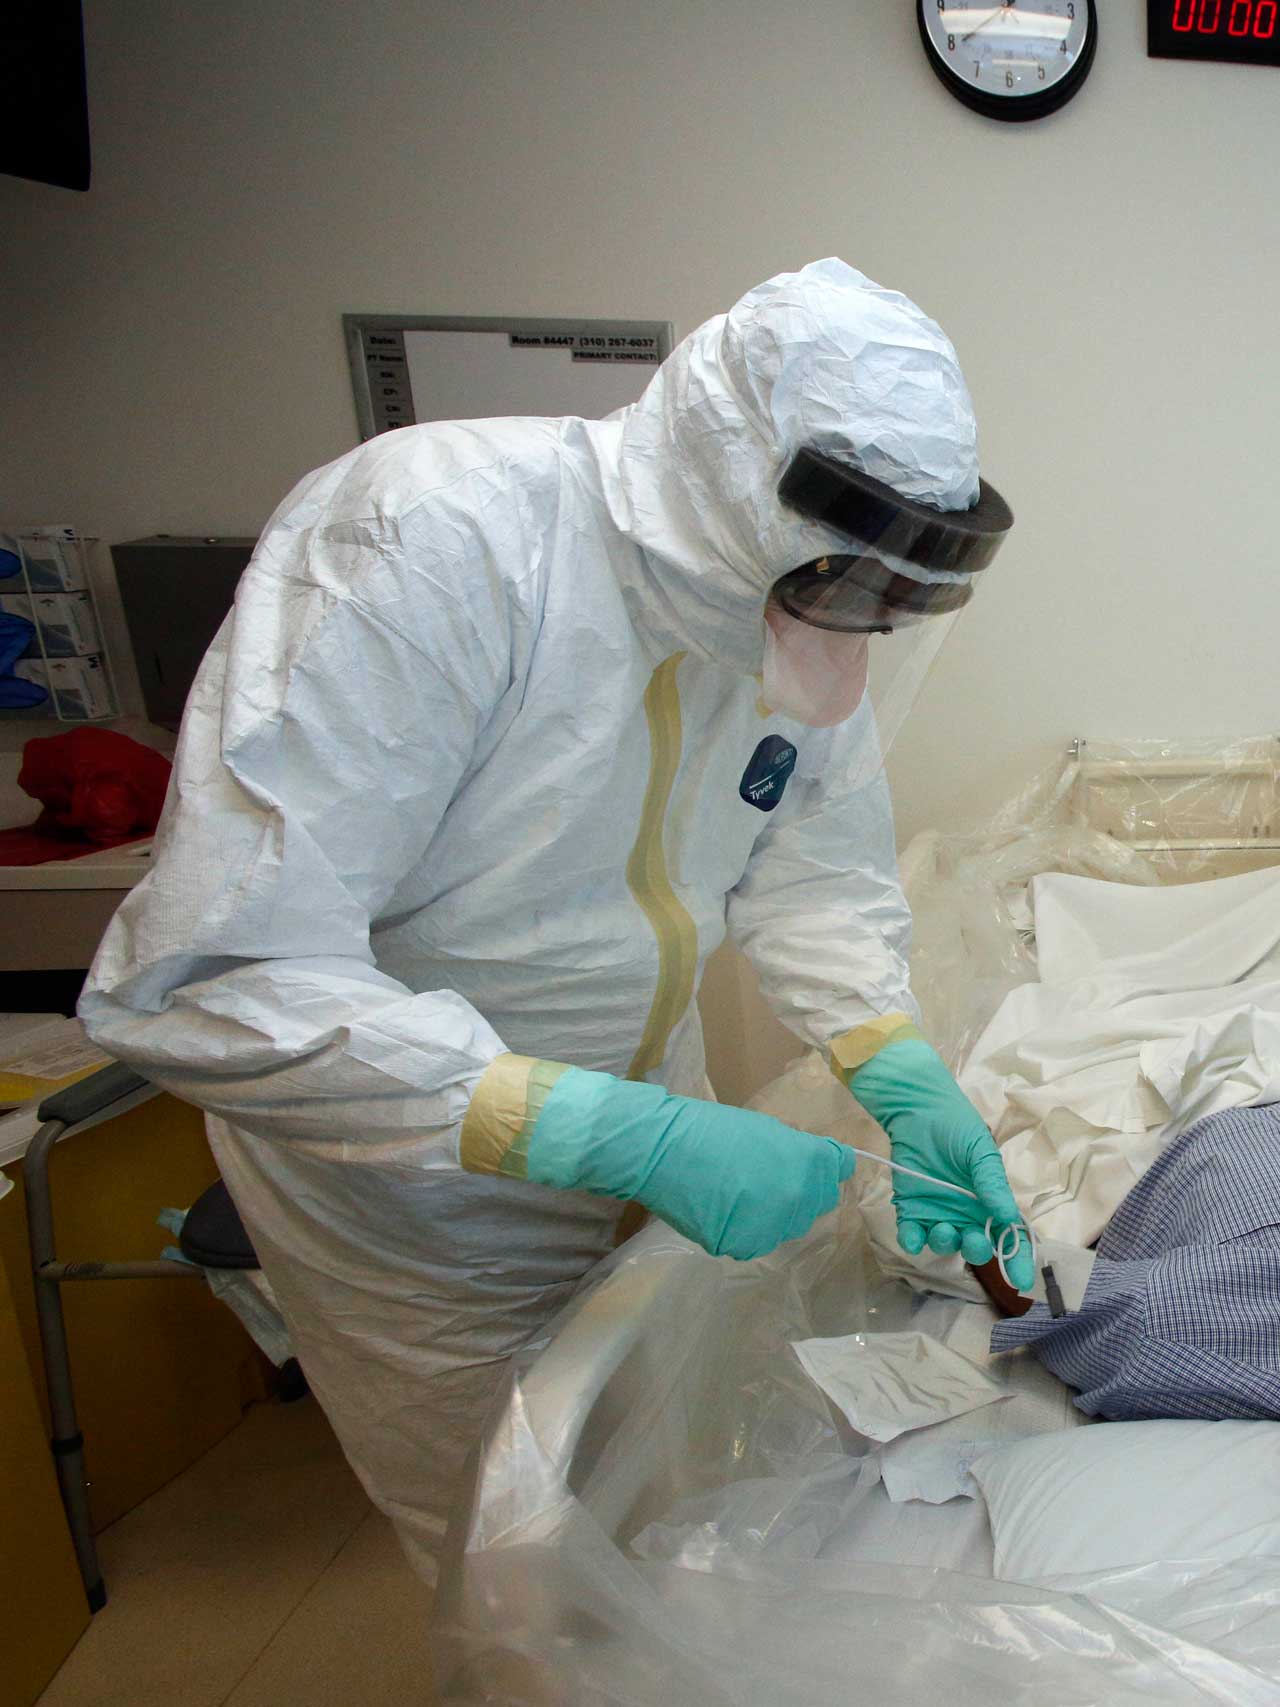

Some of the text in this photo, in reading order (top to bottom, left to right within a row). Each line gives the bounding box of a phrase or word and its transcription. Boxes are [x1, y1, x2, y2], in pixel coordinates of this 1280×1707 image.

[1067, 3, 1075, 19] 3
[947, 34, 956, 51] 8
[1059, 39, 1067, 55] 4
[973, 60, 982, 78] 7
[1037, 64, 1046, 80] 5
[1005, 71, 1014, 88] 6
[512, 335, 541, 346] Room
[580, 337, 606, 347] (310)
[574, 351, 612, 360] PRIMARY
[750, 780, 774, 801] Tyvek
